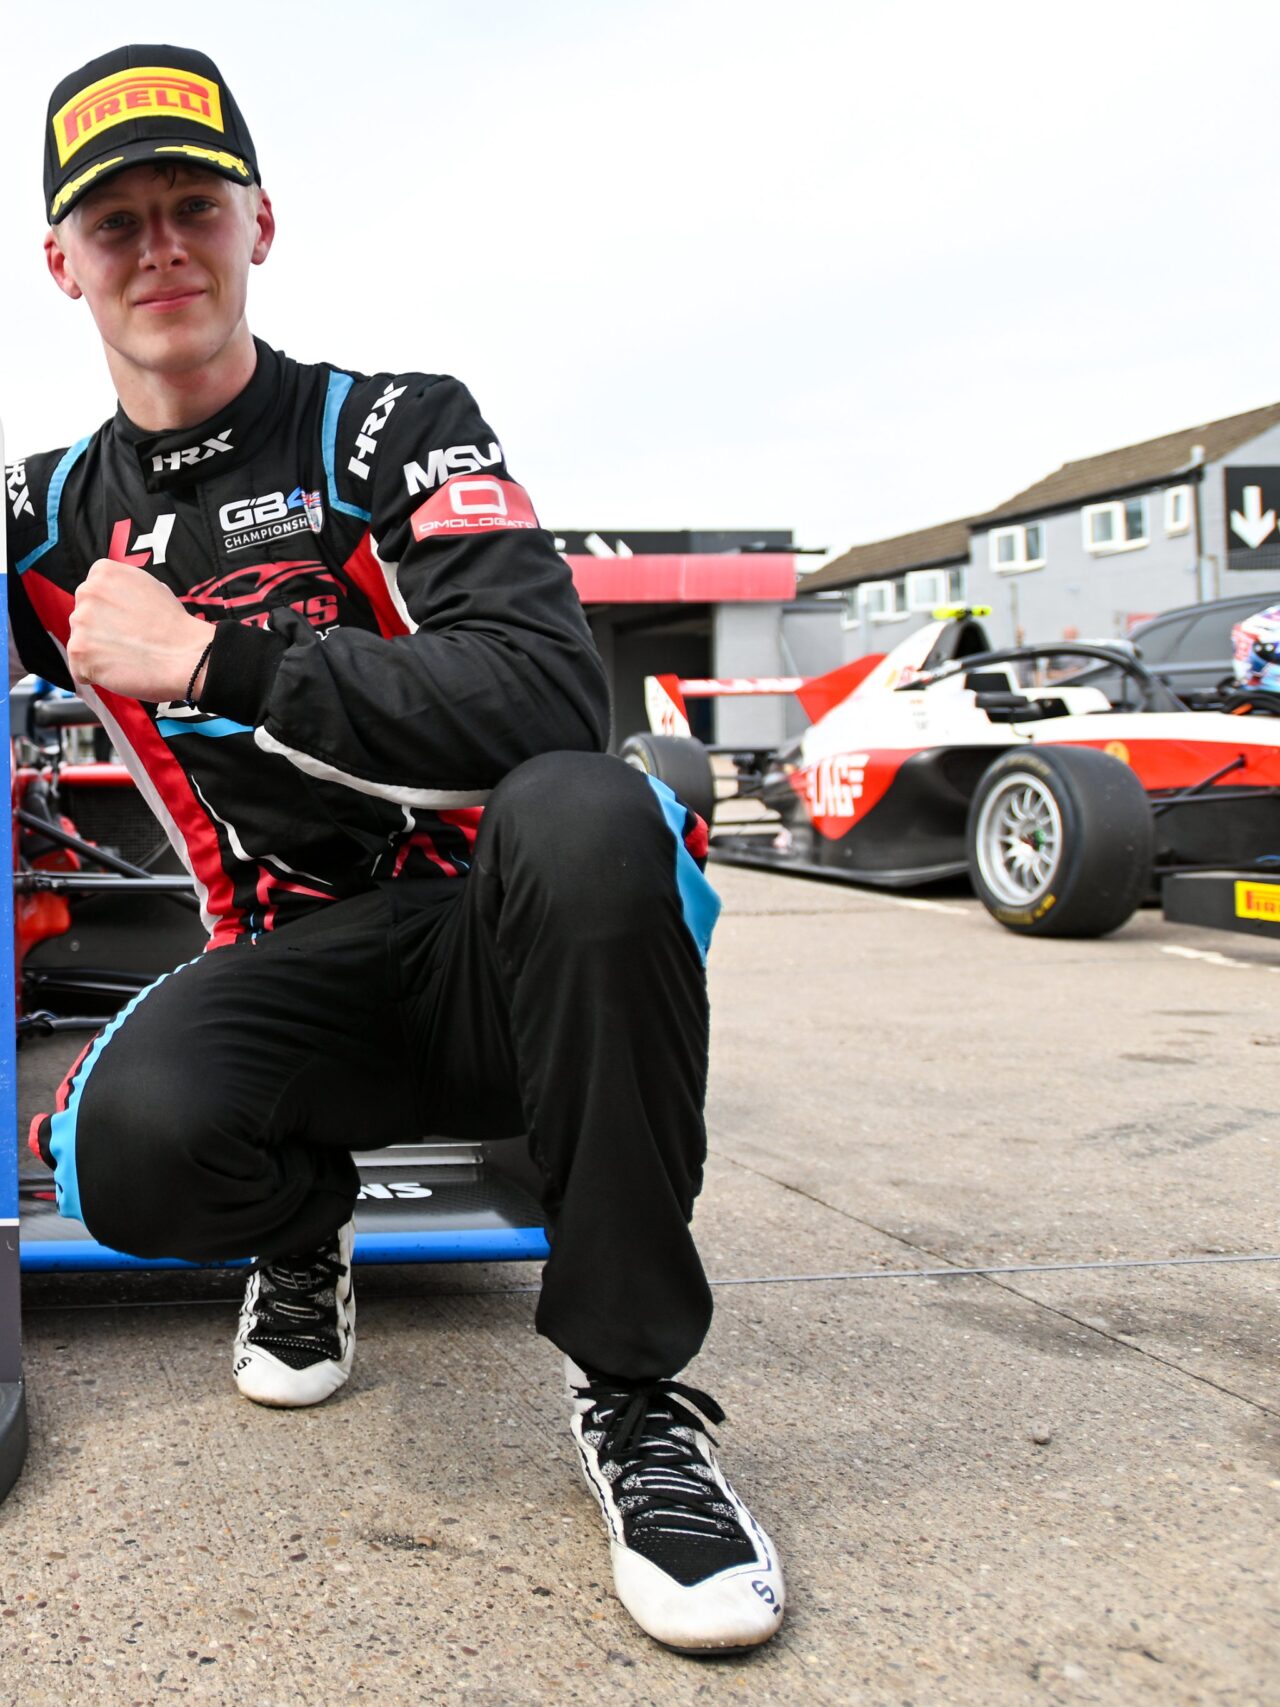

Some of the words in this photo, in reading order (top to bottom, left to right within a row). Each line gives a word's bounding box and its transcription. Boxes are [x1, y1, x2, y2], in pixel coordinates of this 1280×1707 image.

[63, 76, 212, 146] PIRELLI
[151, 428, 235, 473] HRX
[346, 382, 409, 481] HRX
[224, 516, 309, 549] CHAMPIONSH
